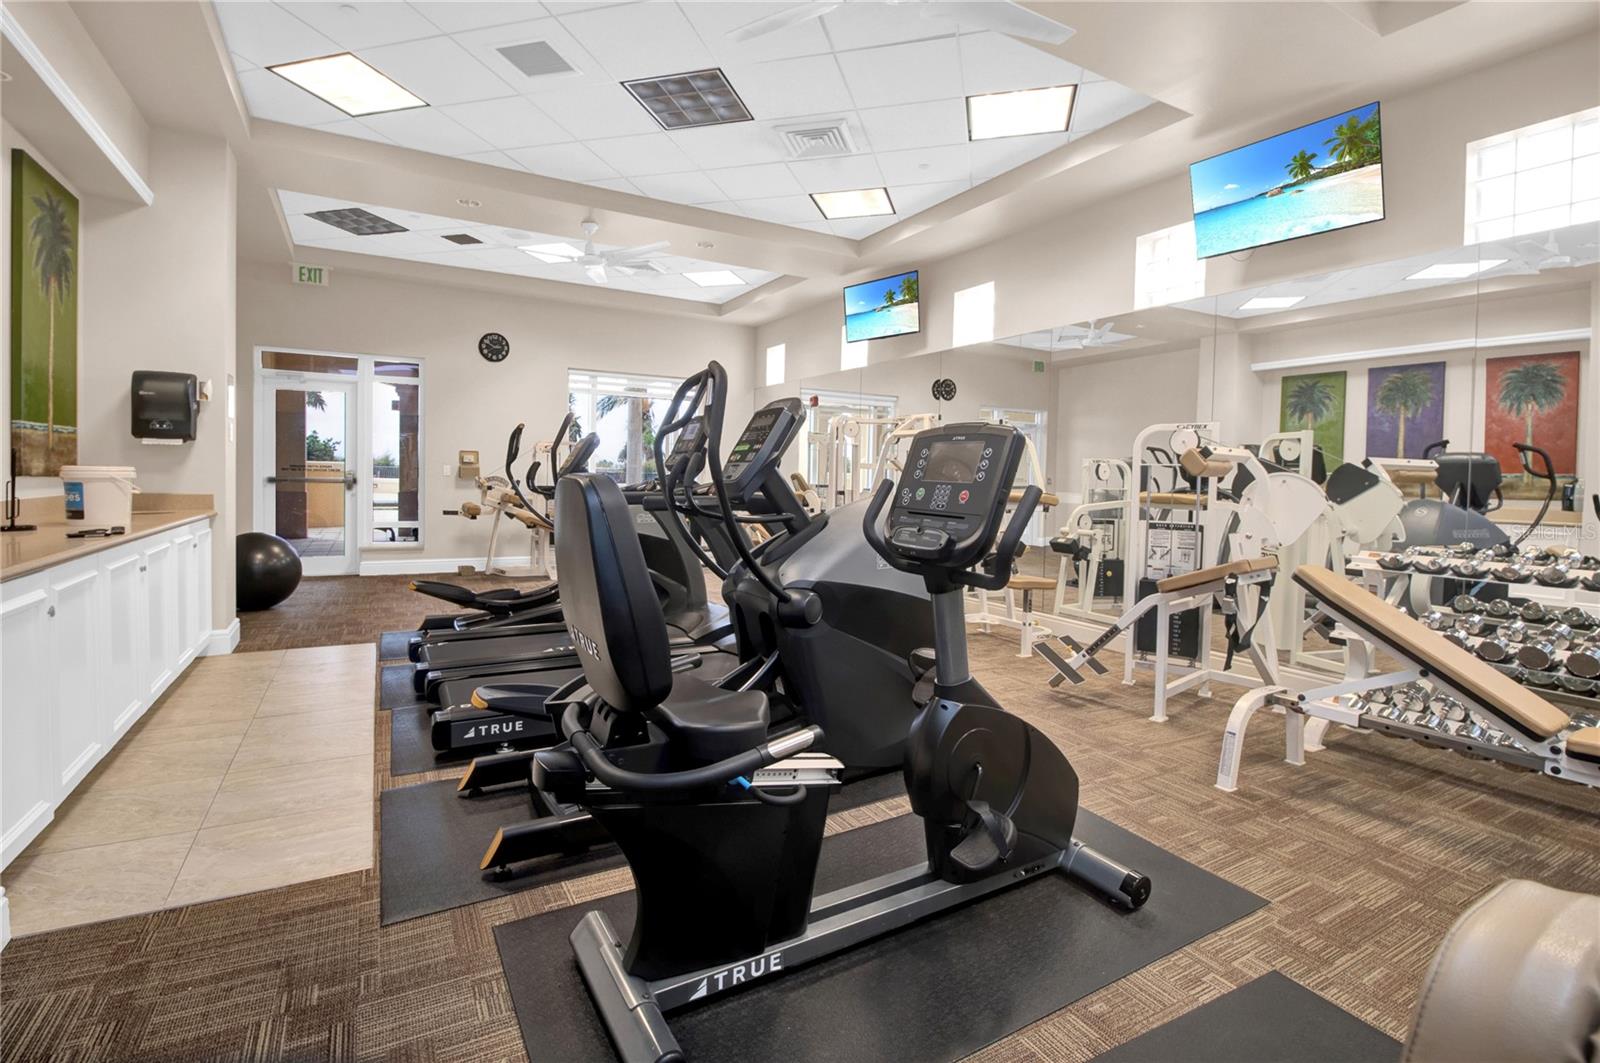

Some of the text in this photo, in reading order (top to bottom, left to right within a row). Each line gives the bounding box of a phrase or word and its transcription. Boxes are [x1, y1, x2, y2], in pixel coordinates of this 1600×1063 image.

[299, 266, 323, 283] EXIT
[574, 628, 601, 661] TRUE
[478, 720, 523, 736] TRUE
[713, 953, 782, 991] TRUE
